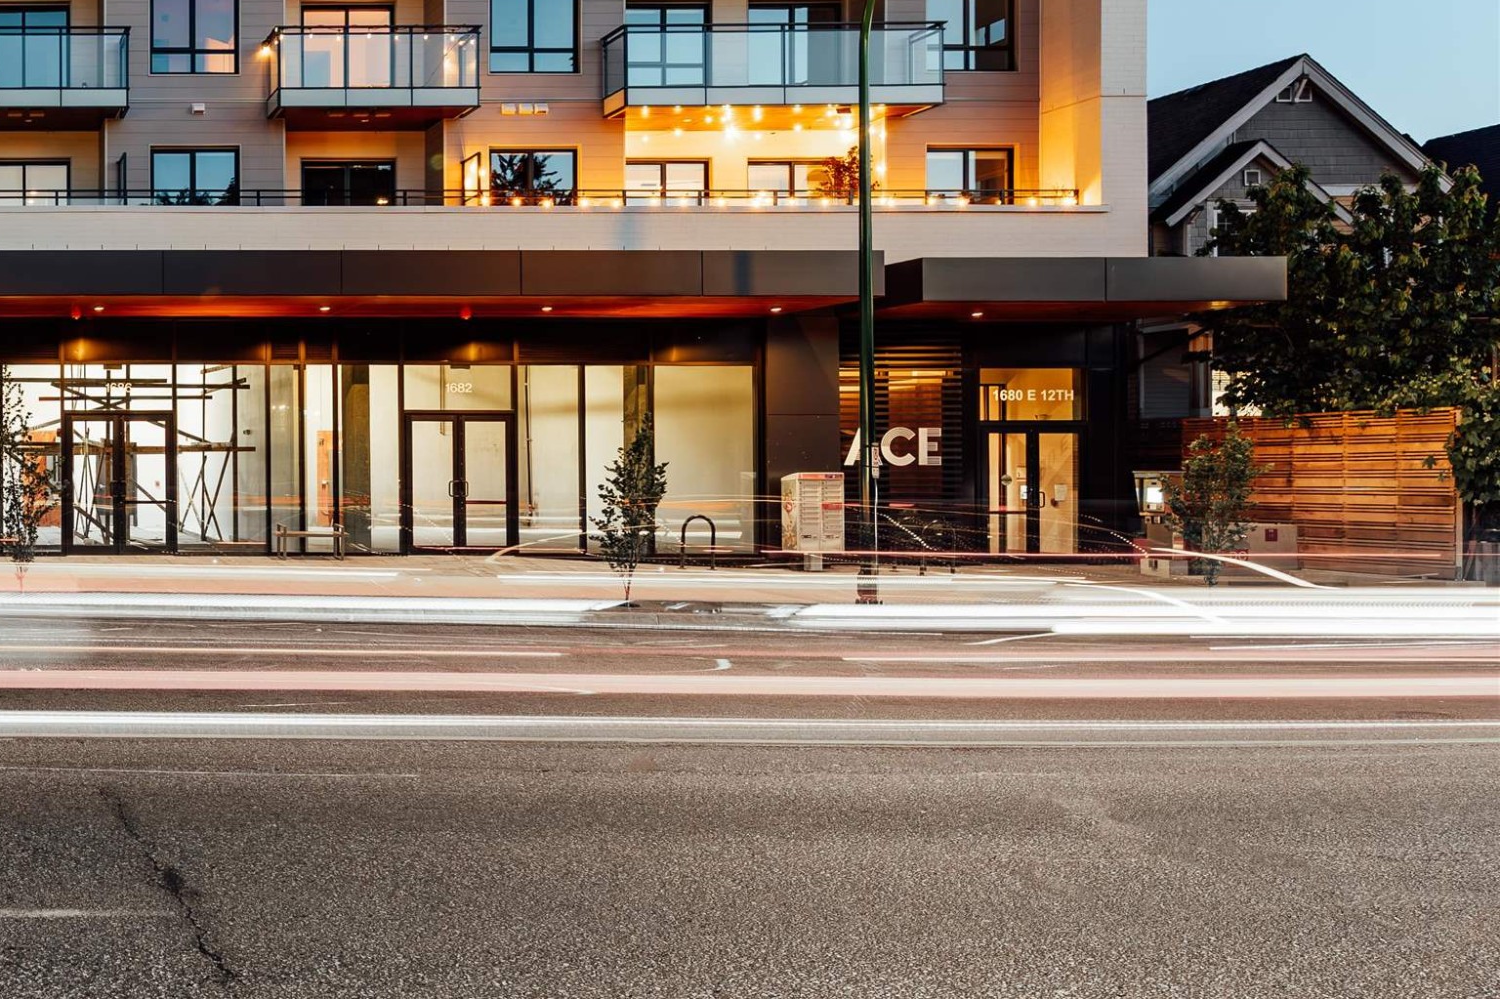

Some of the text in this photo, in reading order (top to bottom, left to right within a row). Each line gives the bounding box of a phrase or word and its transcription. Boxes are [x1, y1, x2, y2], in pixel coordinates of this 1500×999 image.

[445, 382, 473, 393] 1682
[993, 389, 1074, 401] 1680 E 12TH
